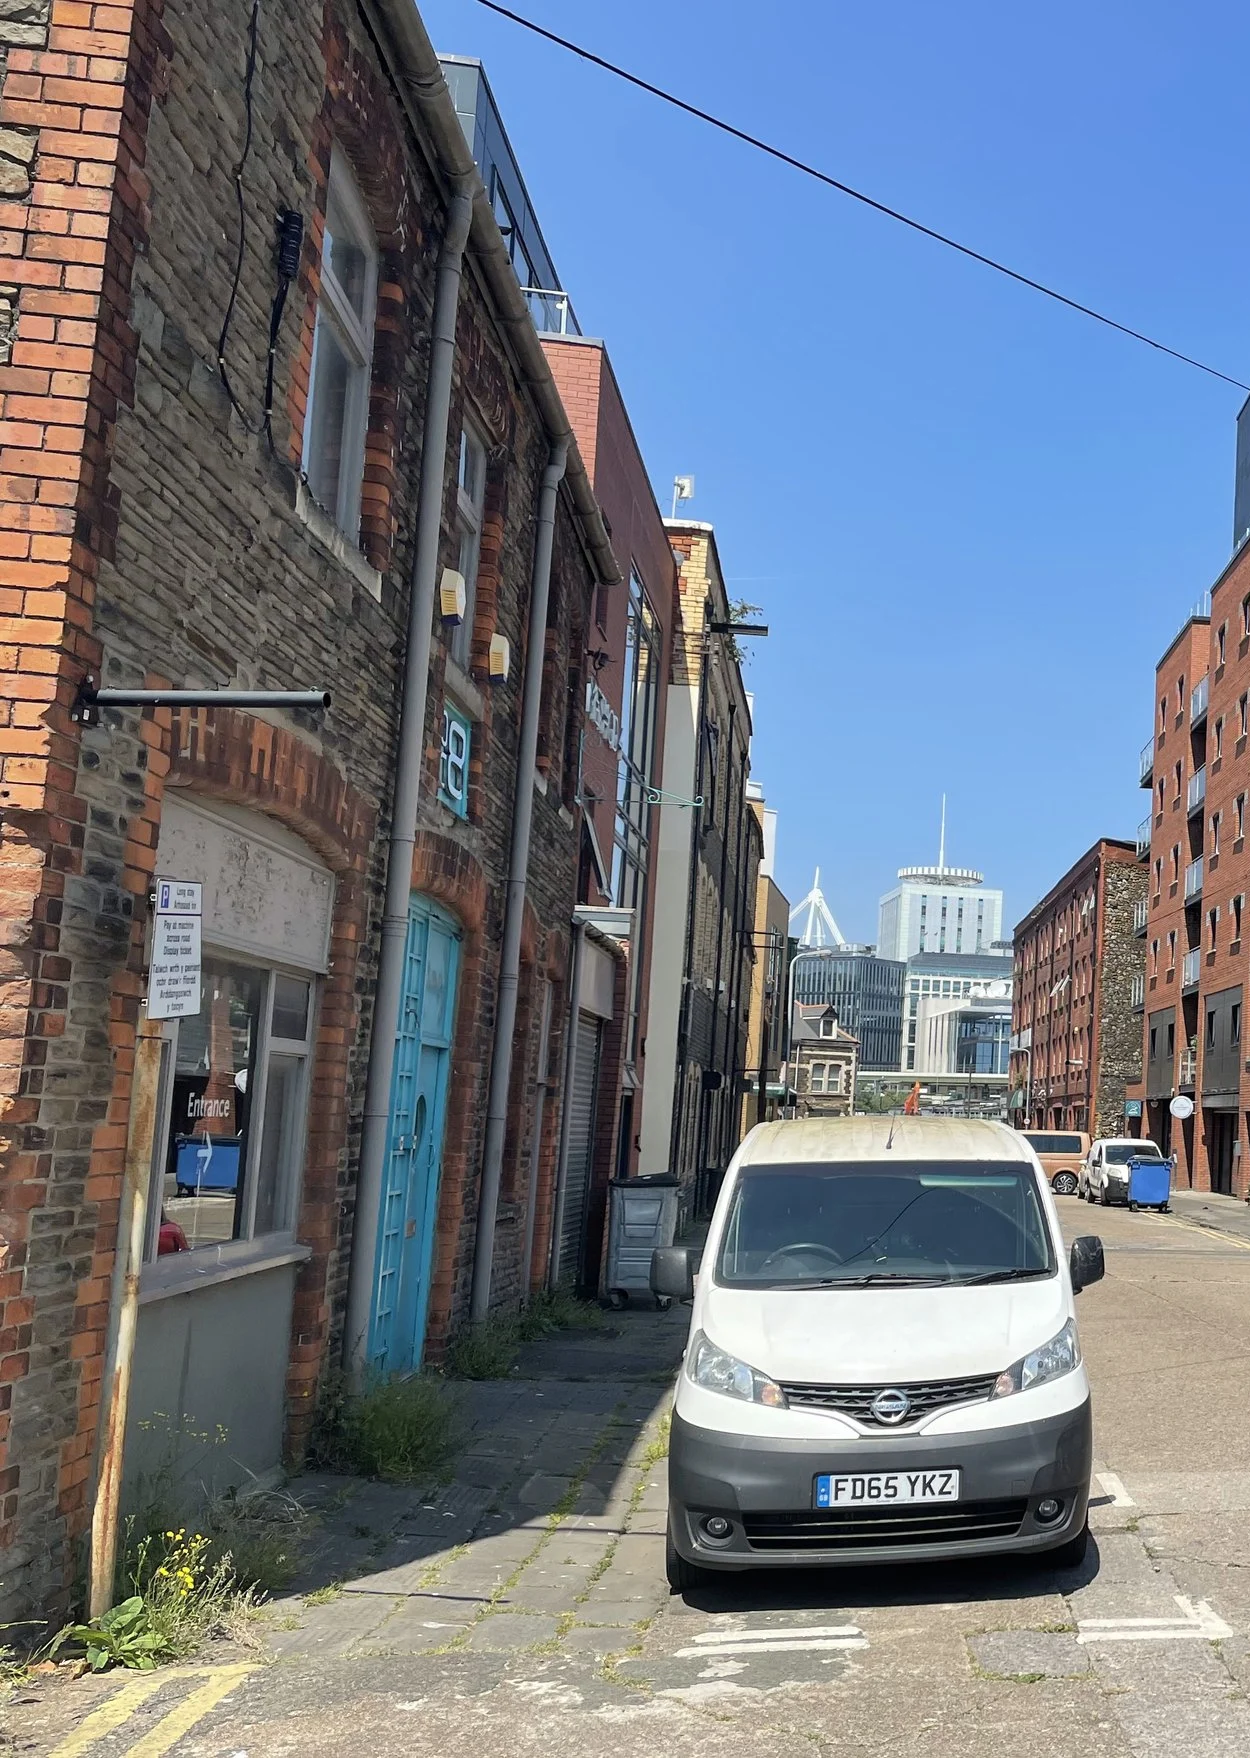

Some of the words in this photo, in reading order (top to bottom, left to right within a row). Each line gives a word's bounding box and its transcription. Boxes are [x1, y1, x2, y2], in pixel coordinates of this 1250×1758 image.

[177, 887, 186, 897] Long
[186, 888, 195, 897] stay
[163, 920, 171, 931] Pay
[178, 921, 194, 930] machine
[166, 934, 180, 942] across
[163, 945, 179, 956] Display
[187, 1092, 230, 1118] Entrance
[834, 1476, 898, 1501] FD65
[906, 1473, 953, 1497] YKZ
